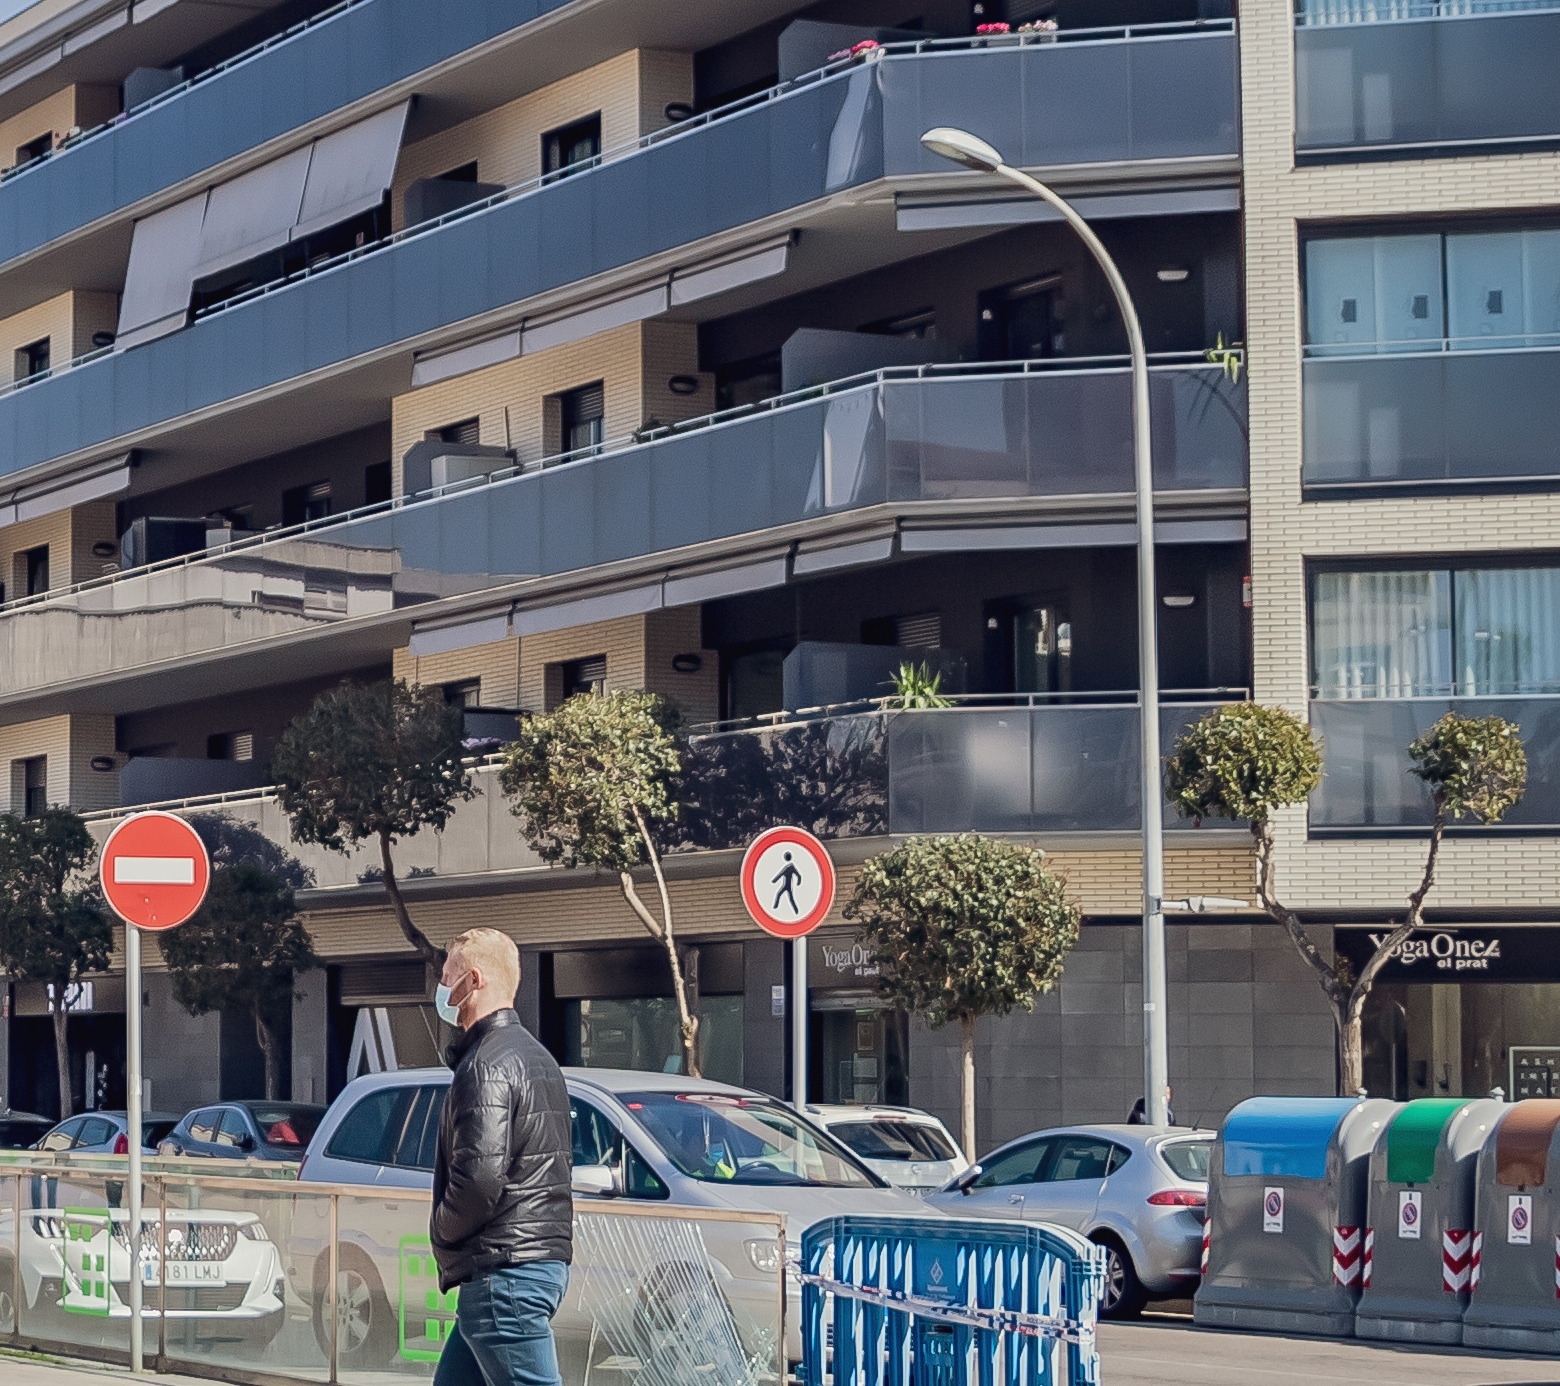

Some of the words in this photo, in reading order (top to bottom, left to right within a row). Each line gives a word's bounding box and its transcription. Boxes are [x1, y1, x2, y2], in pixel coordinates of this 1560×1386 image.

[1436, 957, 1452, 969] el
[1455, 958, 1489, 971] prat
[194, 1264, 221, 1279] LMJ
